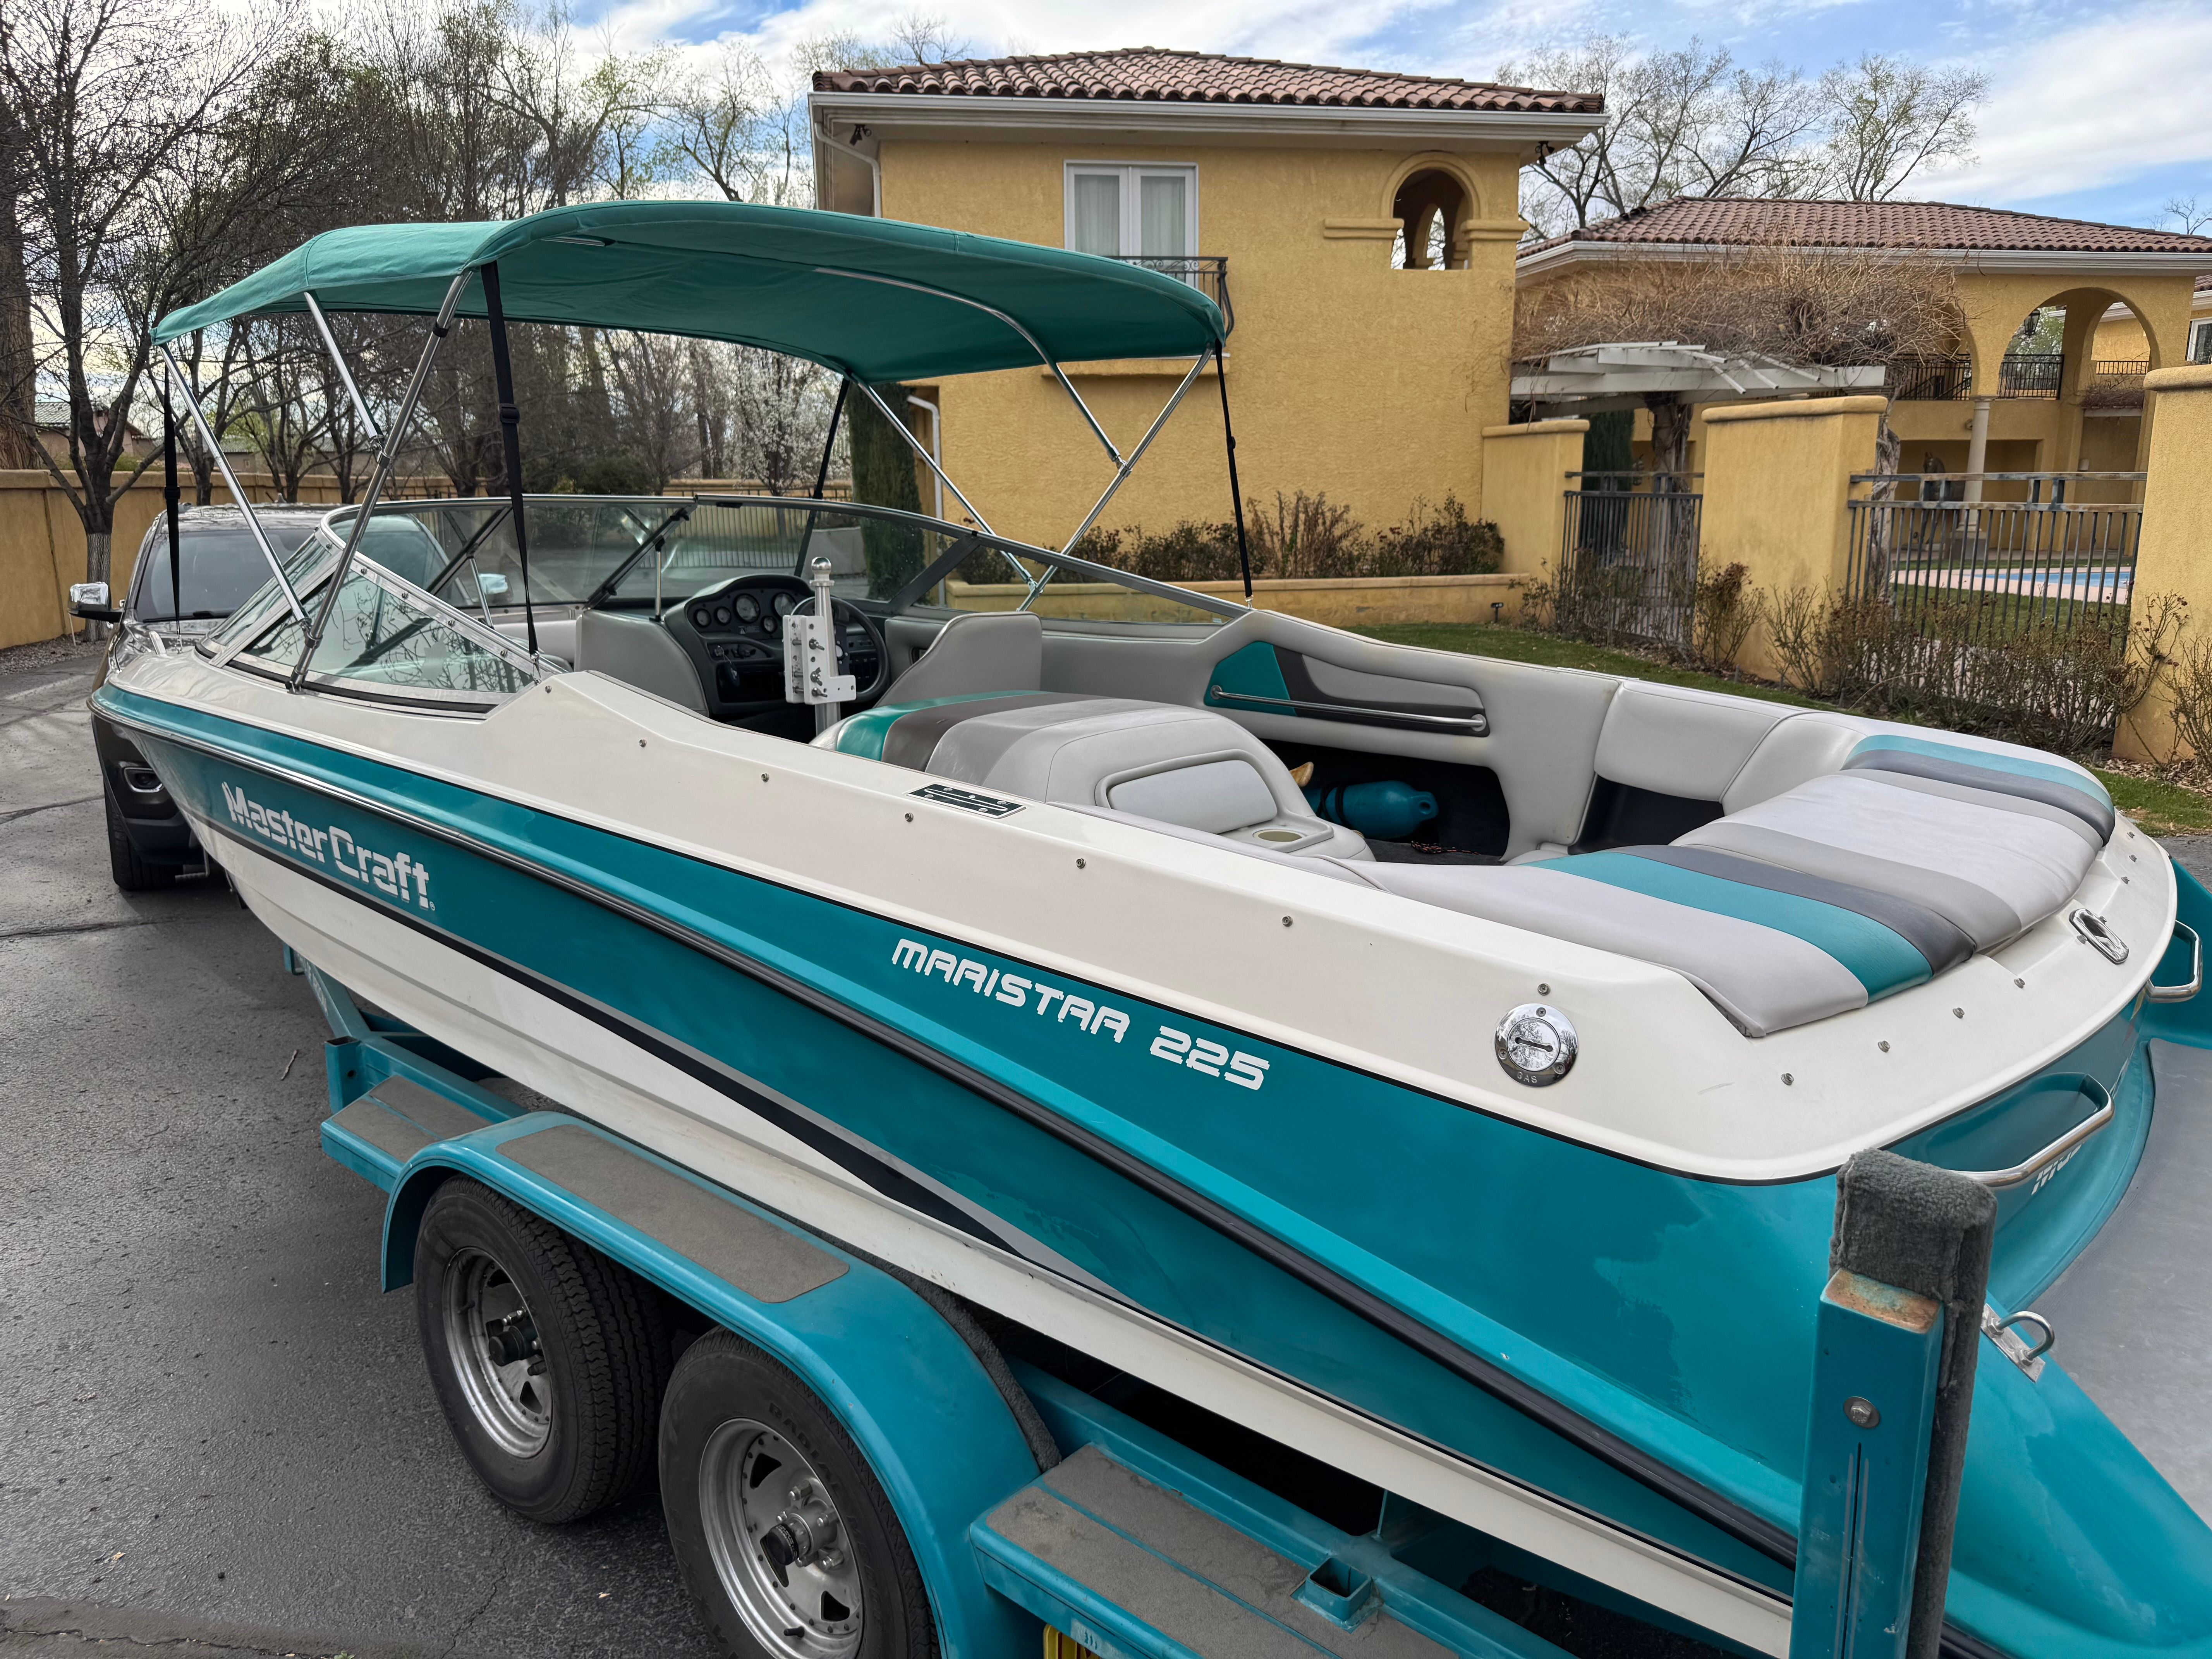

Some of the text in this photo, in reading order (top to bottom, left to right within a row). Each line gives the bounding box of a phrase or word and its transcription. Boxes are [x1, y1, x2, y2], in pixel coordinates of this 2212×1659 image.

[222, 781, 429, 911] MasterCraft
[891, 938, 1270, 1091] MARISTAR 225
[1517, 1072, 1537, 1083] GAS
[768, 1402, 842, 1498] RADIAL
